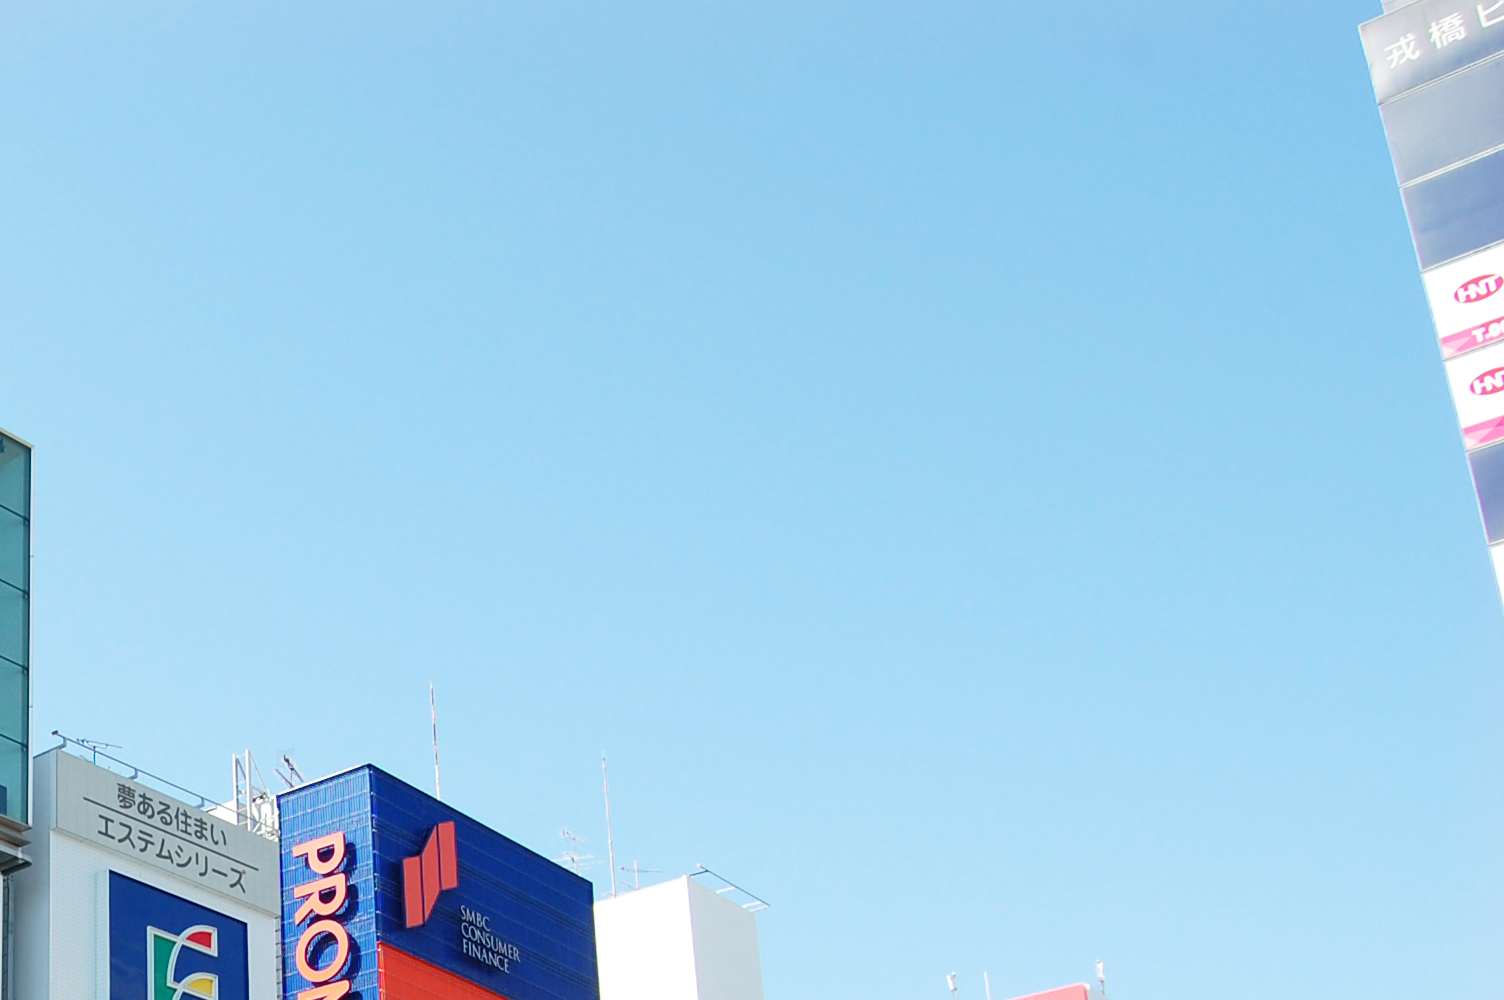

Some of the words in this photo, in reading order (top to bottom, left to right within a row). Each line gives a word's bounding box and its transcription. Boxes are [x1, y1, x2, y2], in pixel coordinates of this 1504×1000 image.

[1457, 274, 1502, 303] HNT
[116, 782, 228, 847] 夢ある住まい
[97, 813, 247, 893] エステムシリーズ
[460, 904, 491, 933] SMBC
[460, 921, 521, 964] CONSUMER
[462, 939, 511, 975] FINANCE
